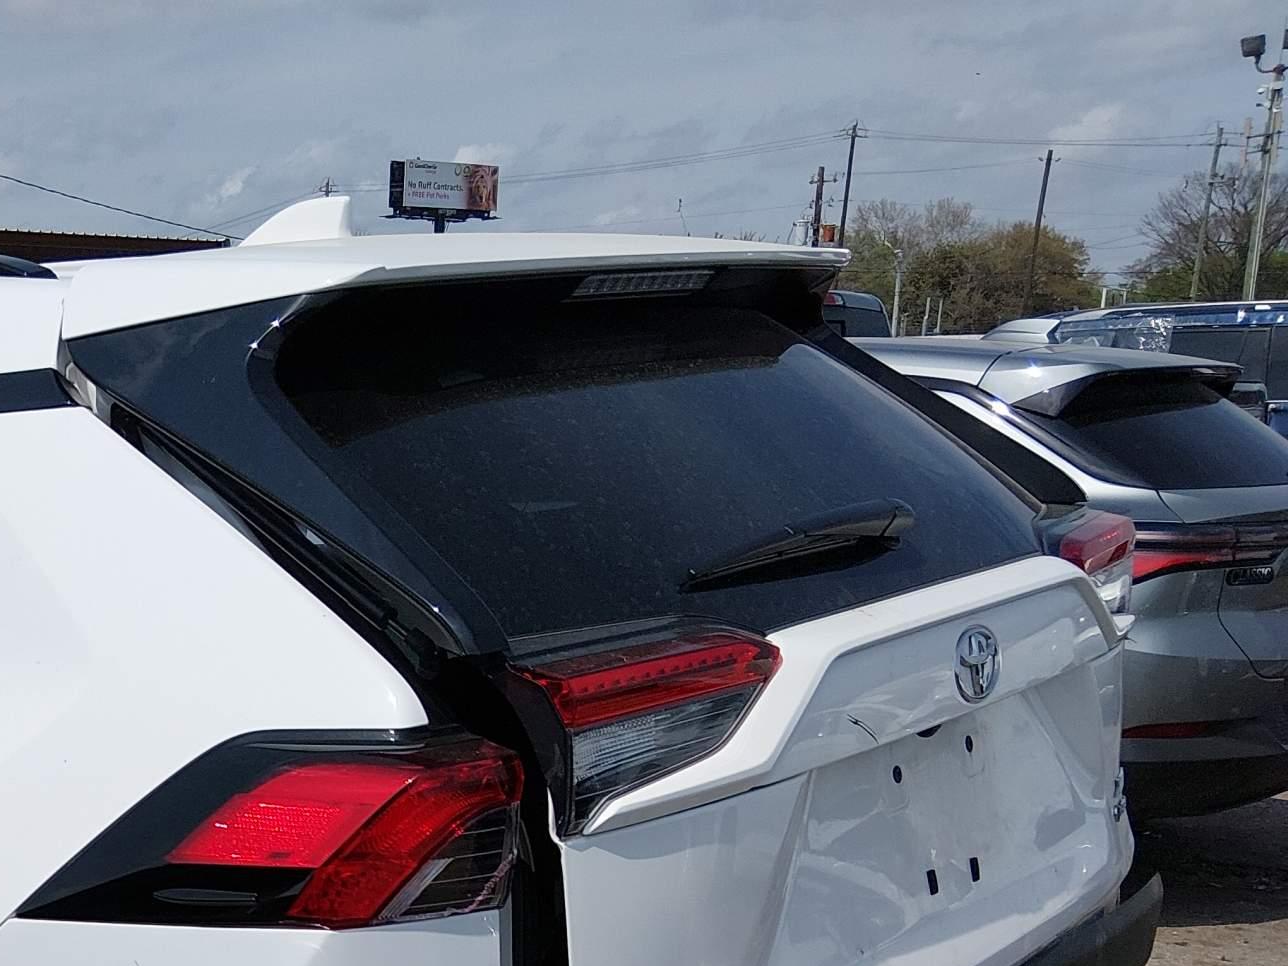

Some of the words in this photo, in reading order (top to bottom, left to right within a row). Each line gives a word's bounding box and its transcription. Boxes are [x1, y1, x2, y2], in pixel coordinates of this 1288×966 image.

[408, 180, 416, 189] No
[418, 181, 432, 190] Ruff
[411, 191, 424, 199] FREE
